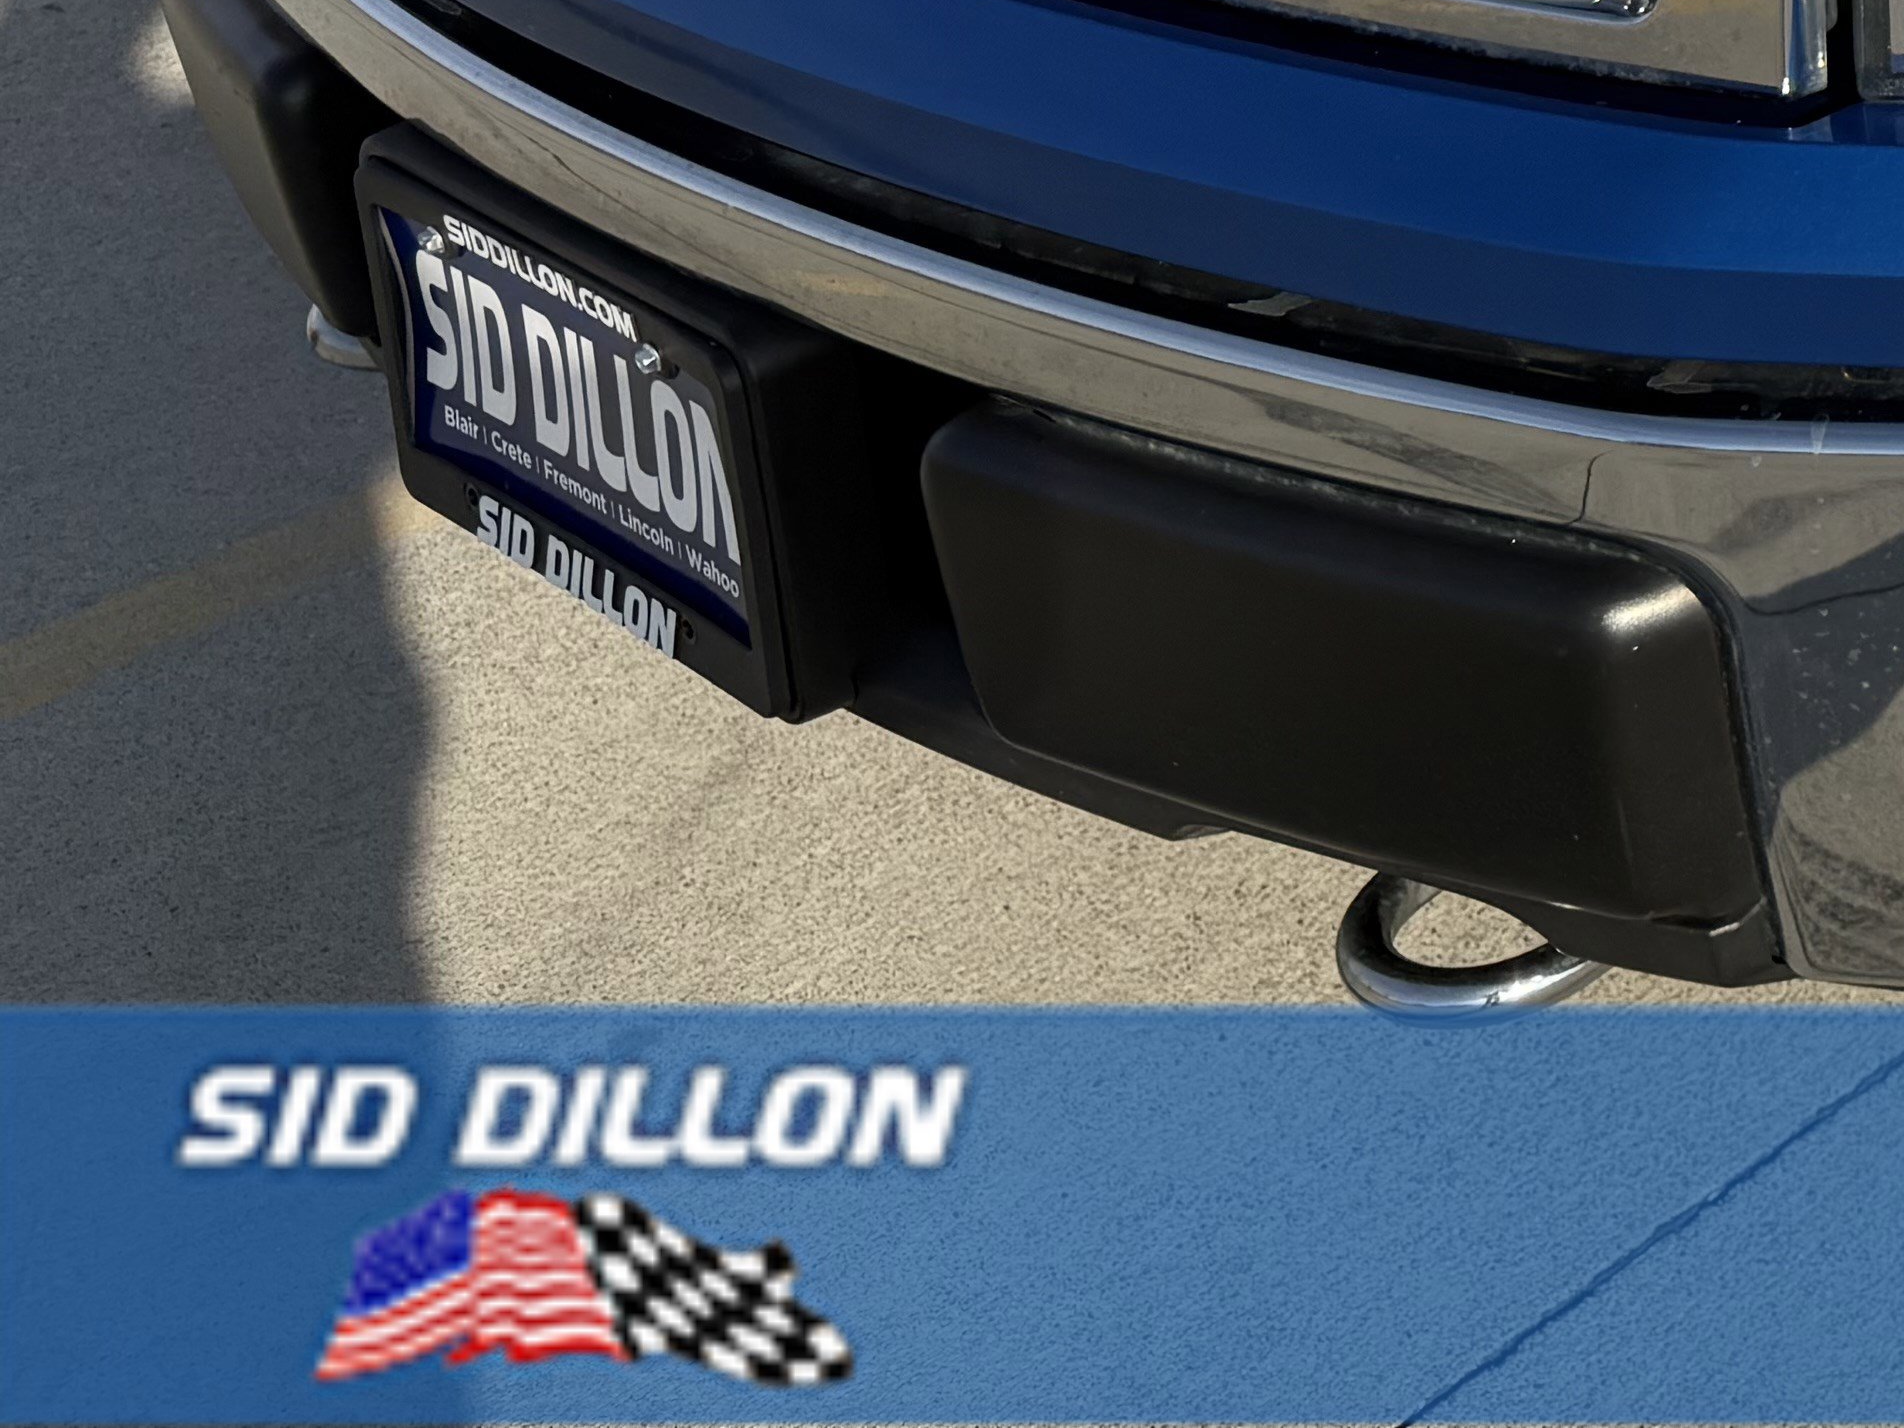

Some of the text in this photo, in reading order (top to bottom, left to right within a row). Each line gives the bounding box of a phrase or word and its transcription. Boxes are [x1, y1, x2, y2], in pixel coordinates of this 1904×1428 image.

[442, 213, 640, 343] SIDDILLON.COM
[414, 246, 742, 567] SID DILLON
[443, 404, 741, 600] Blair Crete Fremont Lincoln Wahoo
[476, 494, 678, 660] SID DILLON
